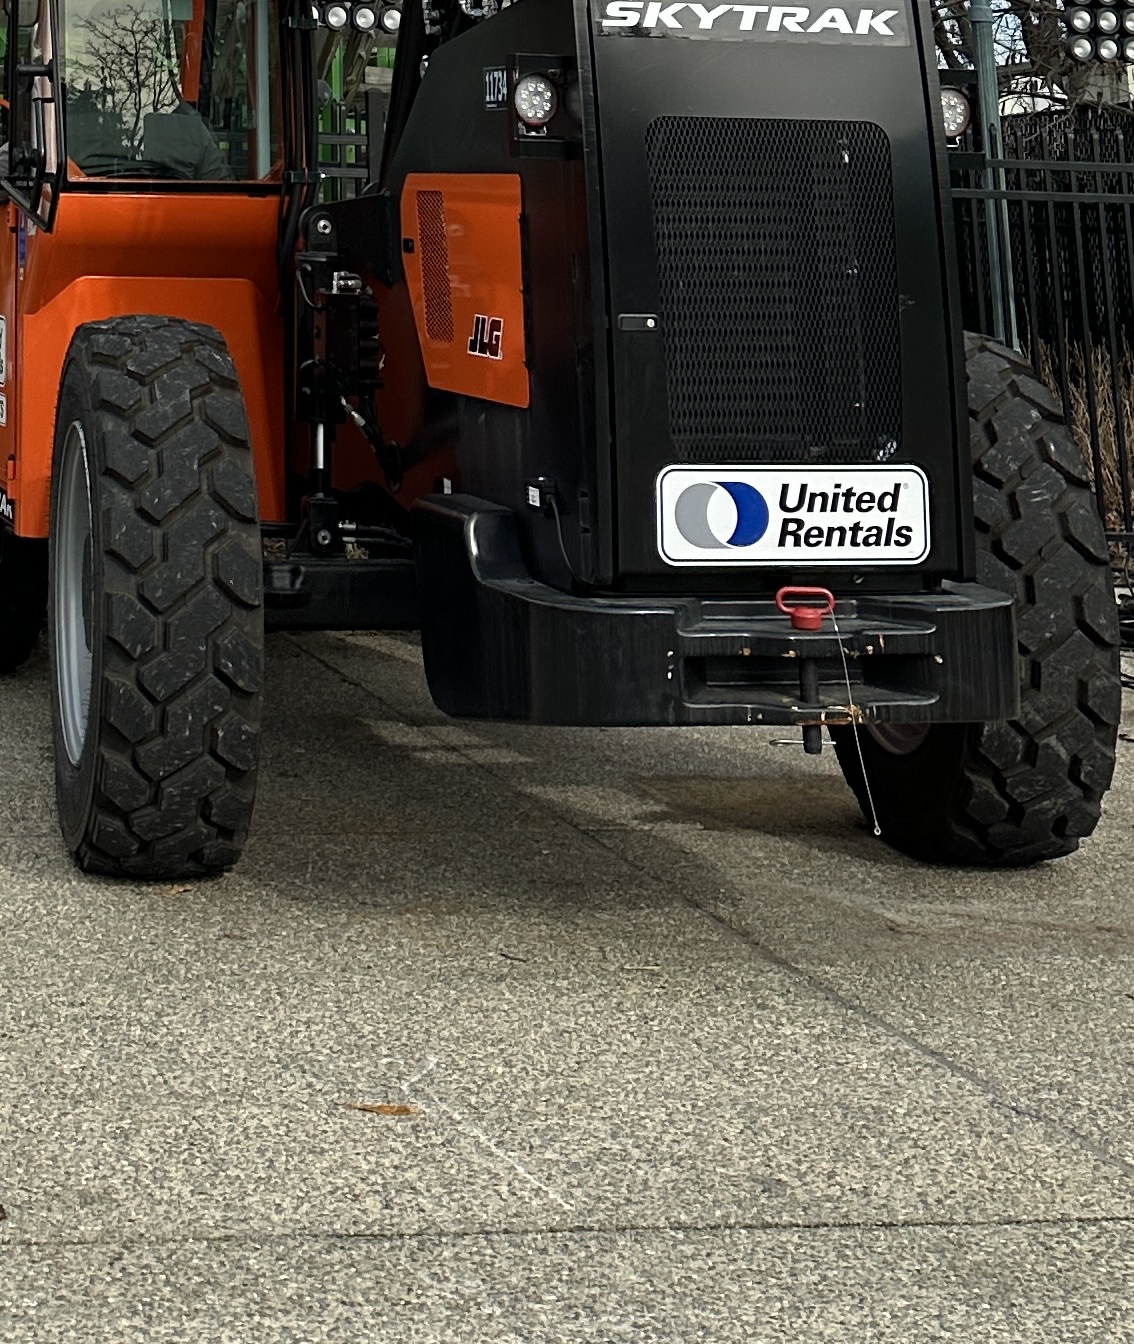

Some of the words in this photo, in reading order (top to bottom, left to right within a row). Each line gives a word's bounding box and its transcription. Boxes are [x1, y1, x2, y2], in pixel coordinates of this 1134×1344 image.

[601, 0, 899, 36] SKYTRAK
[467, 313, 504, 360] JLG
[778, 482, 902, 513] United
[777, 517, 914, 548] Rentals
